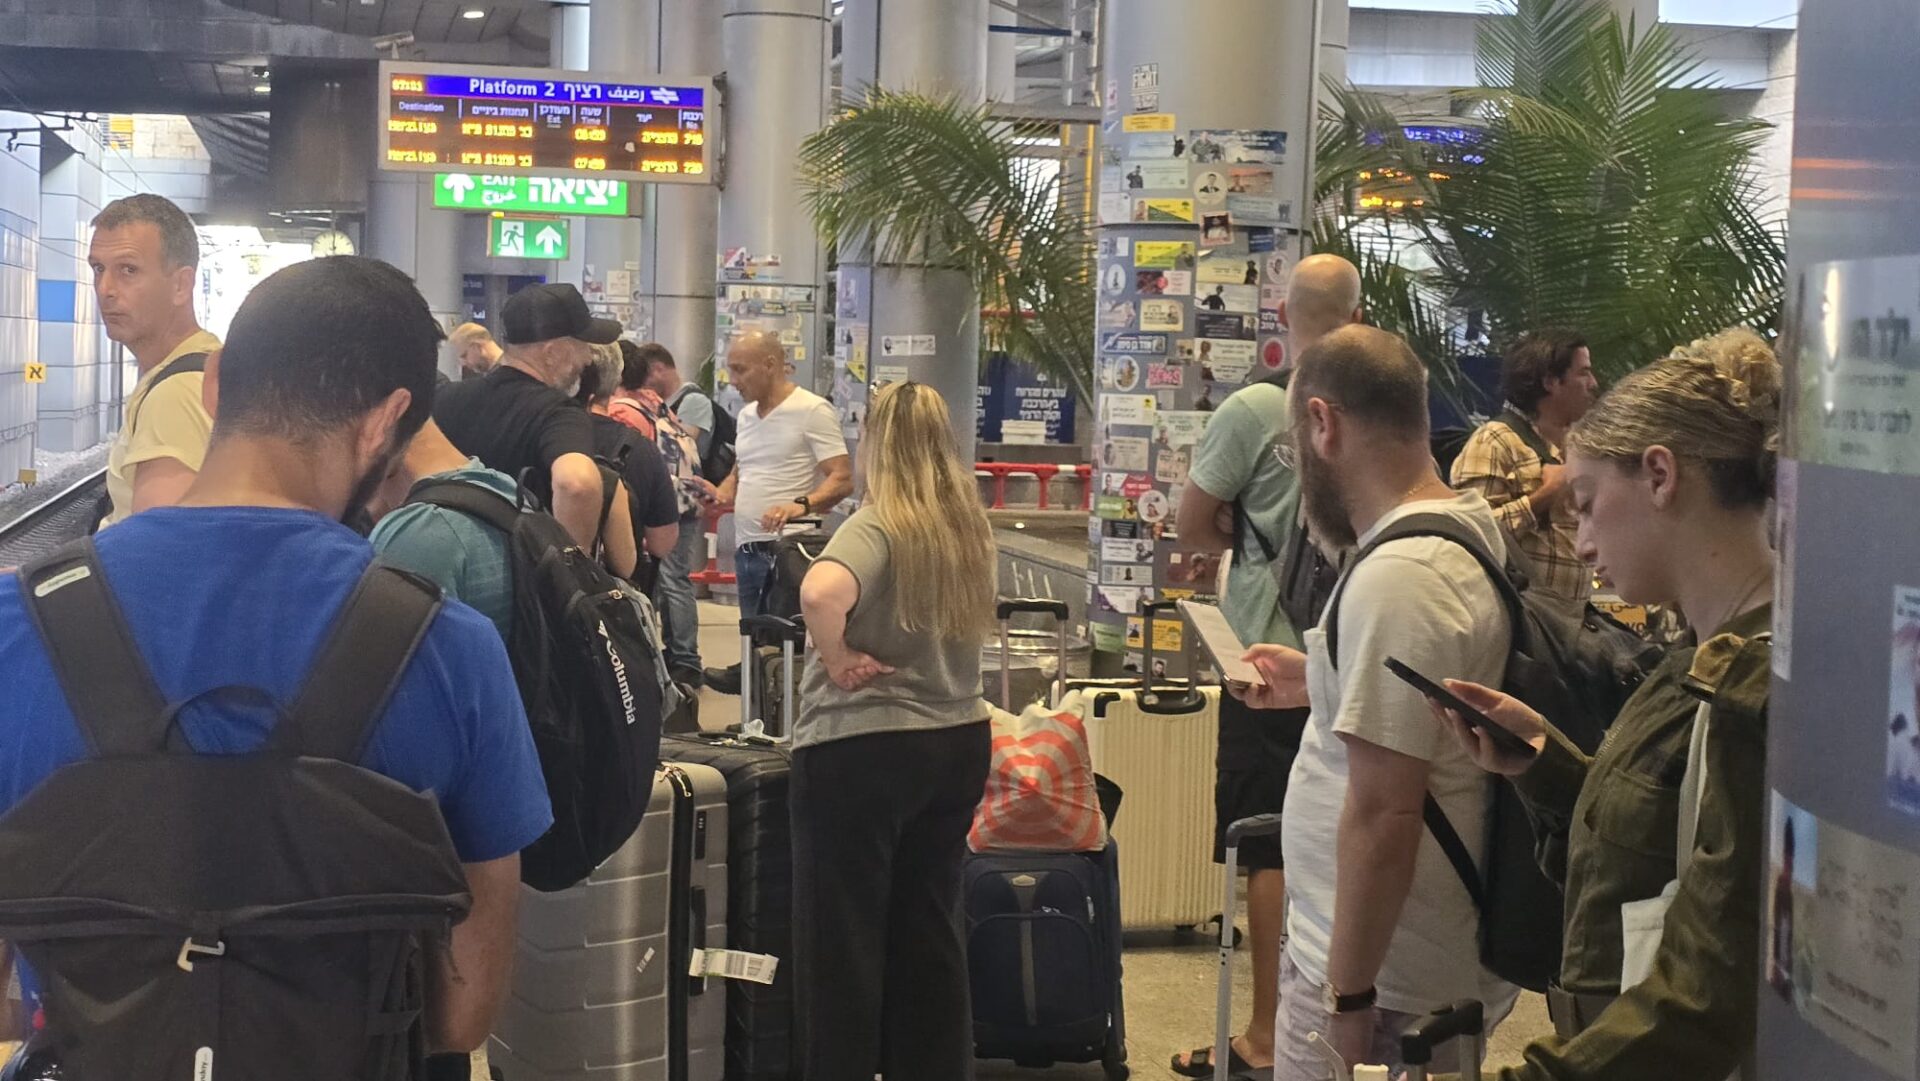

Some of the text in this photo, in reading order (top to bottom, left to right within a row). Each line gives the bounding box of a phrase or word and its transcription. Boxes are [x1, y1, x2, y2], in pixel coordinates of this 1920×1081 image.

[469, 78, 556, 97] Platform 2
[563, 84, 602, 101] רציף
[607, 87, 645, 103] رصيف
[398, 101, 445, 113] Destination
[580, 106, 602, 117] שעה
[581, 116, 601, 125] Time
[528, 176, 619, 206] יציאה
[29, 366, 42, 379] א
[606, 639, 637, 725] Columbia
